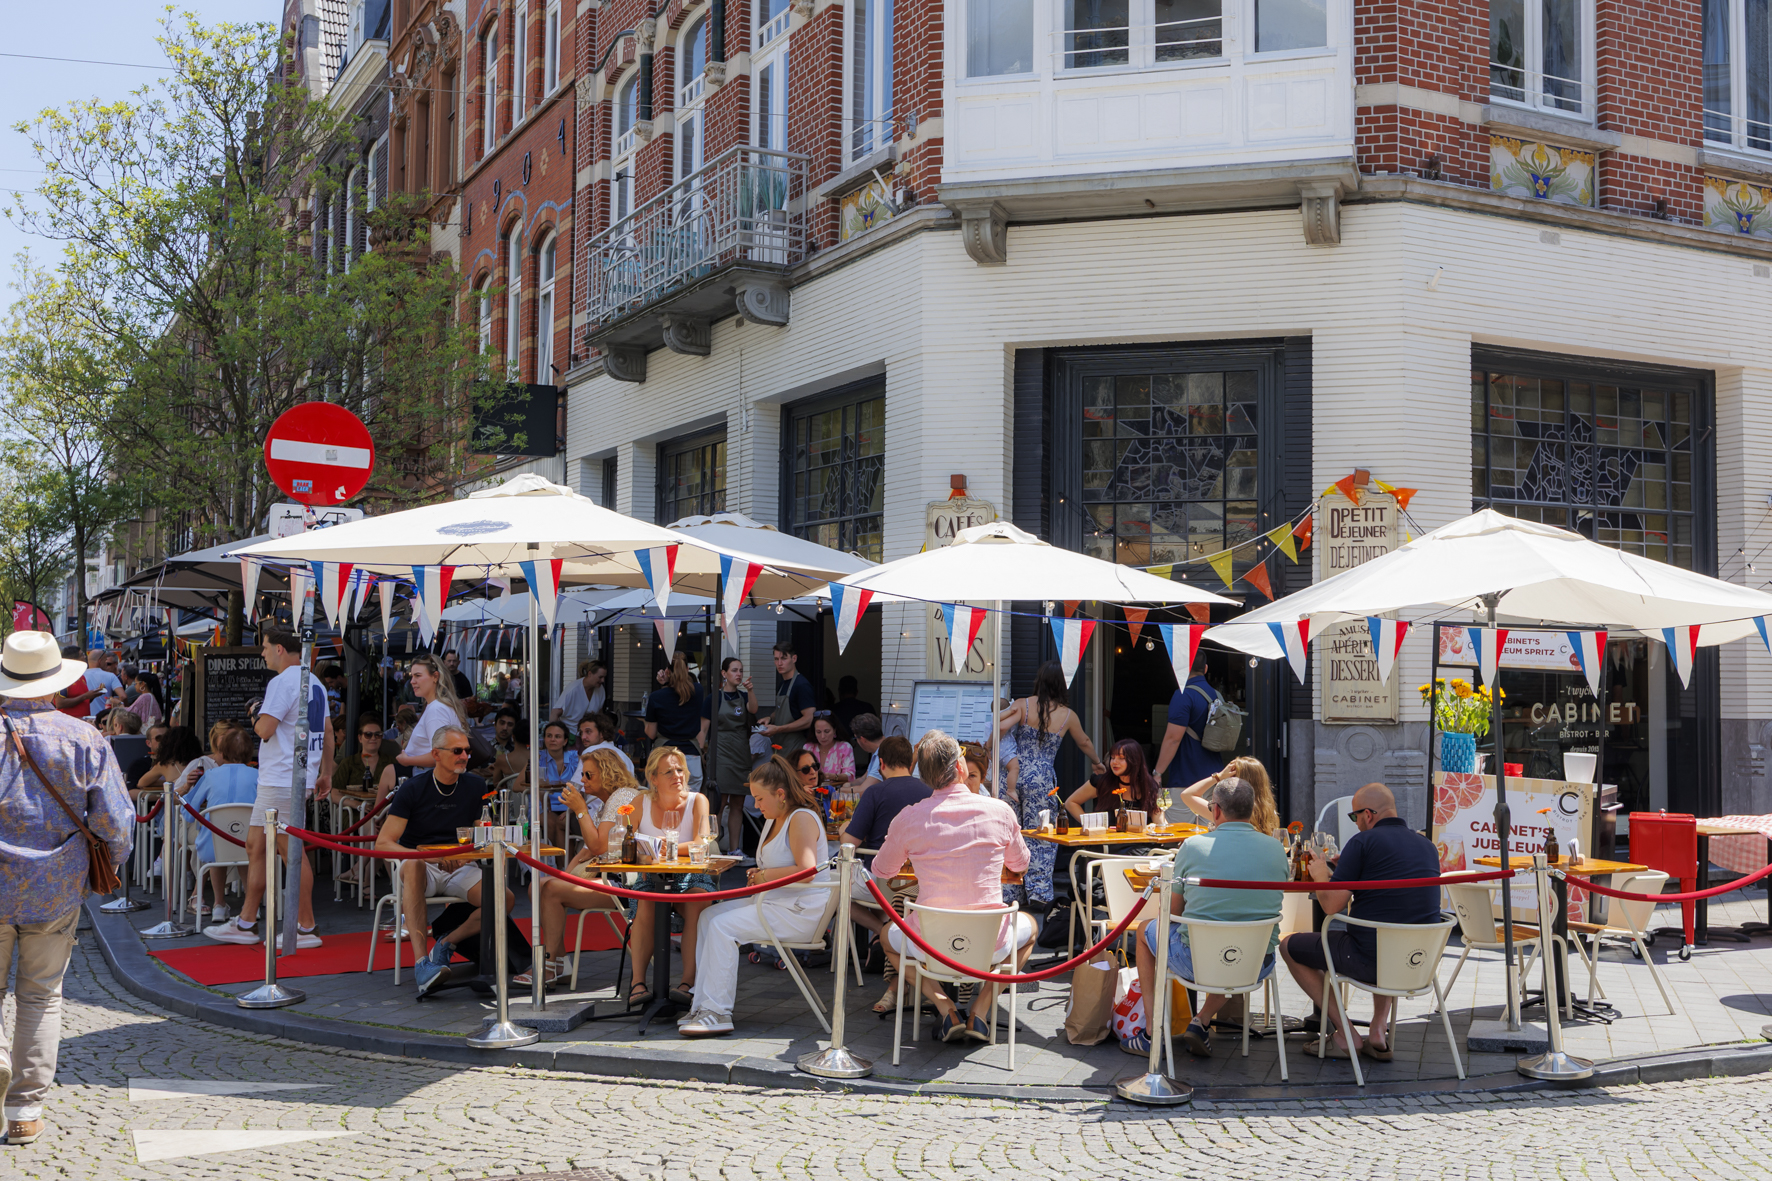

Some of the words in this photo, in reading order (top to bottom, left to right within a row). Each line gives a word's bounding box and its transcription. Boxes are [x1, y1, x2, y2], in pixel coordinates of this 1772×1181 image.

[1341, 507, 1388, 523] PETIT
[1524, 648, 1555, 656] SPRITZ
[207, 658, 237, 671] DINER
[1330, 659, 1390, 681] DESSERT
[1332, 695, 1389, 704] CABINET
[1531, 702, 1637, 724] CABINET
[1559, 730, 1588, 738] BISTROT
[1595, 729, 1609, 738] BR
[1471, 838, 1545, 854] JUBLEUM
